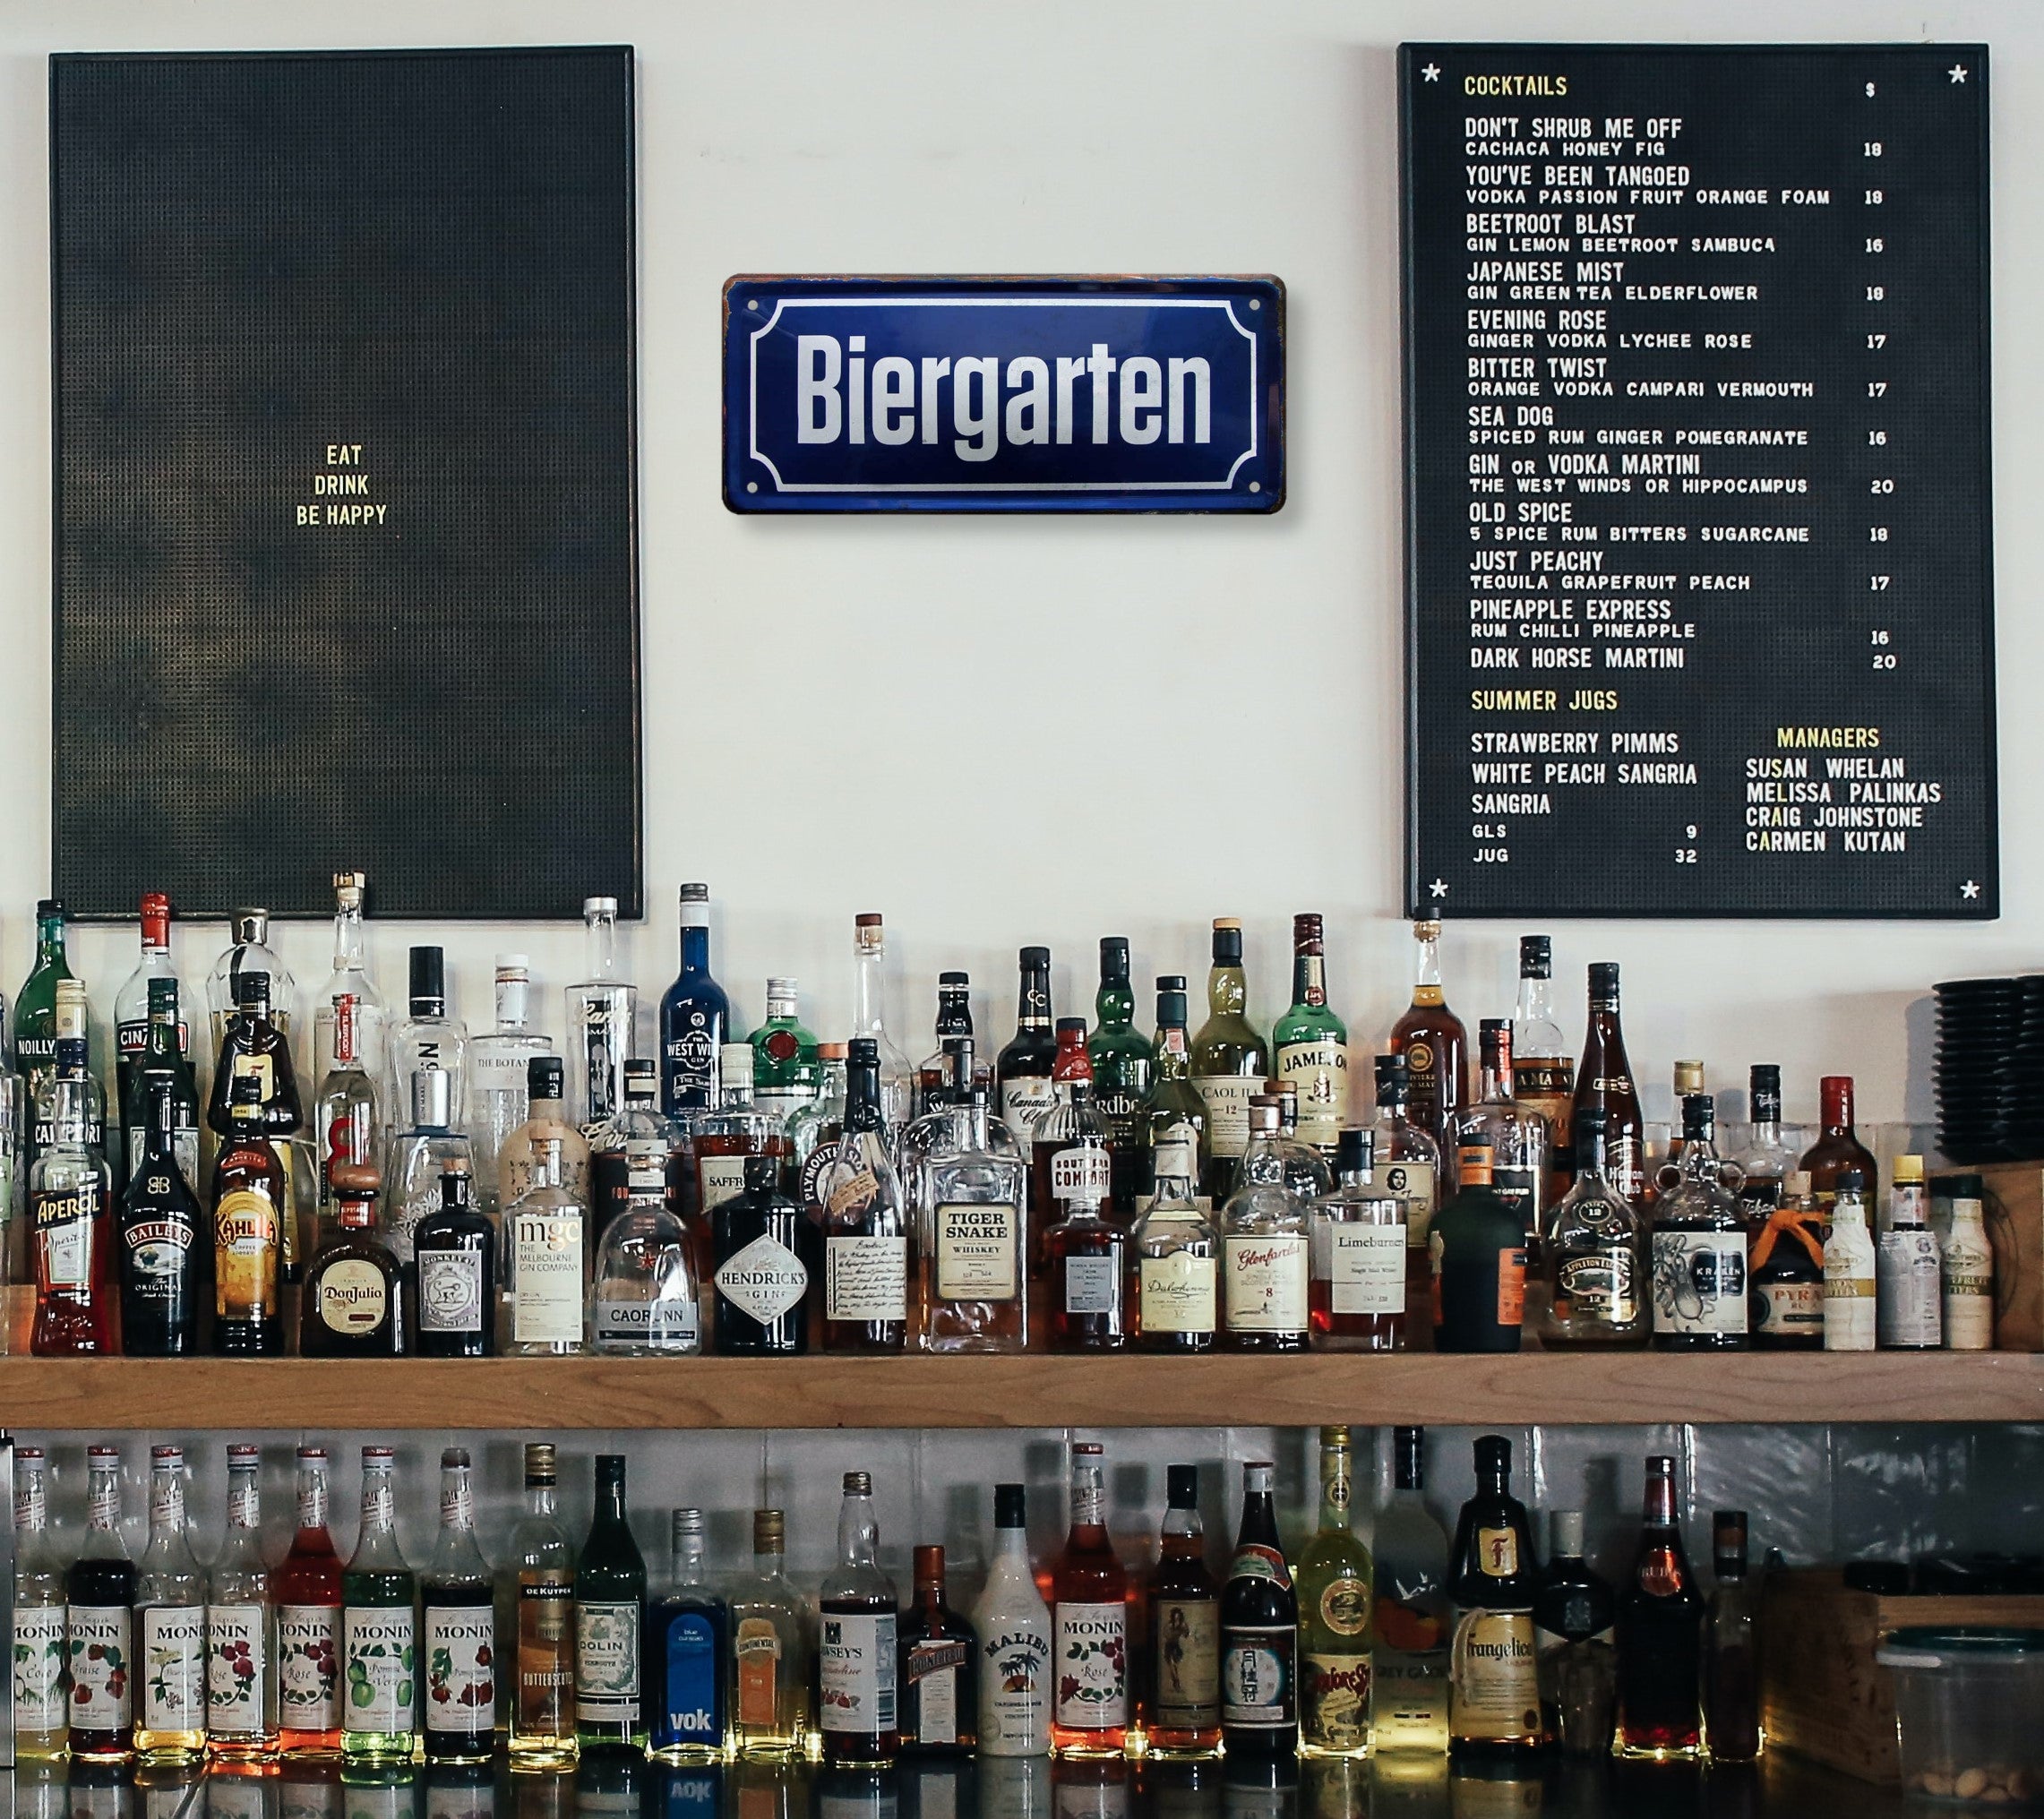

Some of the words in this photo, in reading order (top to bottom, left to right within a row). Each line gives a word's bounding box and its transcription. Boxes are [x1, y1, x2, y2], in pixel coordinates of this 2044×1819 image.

[1464, 75, 1567, 96] COCKTAILS
[1865, 82, 1876, 99] $
[1464, 116, 1519, 138] DON'T
[1532, 117, 1592, 139] SHRUB
[1604, 117, 1635, 139] ME
[1646, 117, 1682, 139] OFF
[1465, 141, 1550, 157] CACHACA
[1562, 142, 1623, 157] HONEY
[1636, 142, 1665, 157] FIG
[1864, 142, 1882, 158] 18
[1465, 164, 1532, 186] YOU'VE
[1544, 165, 1593, 186] BEEN
[1604, 165, 1690, 187] TANGOED
[1465, 189, 1526, 204] VODKA
[1539, 189, 1618, 205] PASSION
[1630, 189, 1684, 205] FRUIT
[1696, 189, 1768, 205] ORANGE
[1781, 189, 1830, 205] FOAM
[1865, 190, 1883, 205] 18
[1466, 213, 1563, 235] BEETROOT
[1576, 213, 1636, 235] BLAST
[1466, 236, 1497, 253] GIN
[1509, 237, 1570, 253] LEMON
[1582, 237, 1679, 253] BEETROOT
[1691, 237, 1775, 253] SAMBUCA
[1865, 237, 1884, 253] 16
[1466, 261, 1564, 282] JAPANESE
[1576, 262, 1625, 283] MIST
[1467, 285, 1498, 300] GIN
[1509, 285, 1571, 301] GREEN
[1576, 285, 1612, 301] TEA
[1625, 285, 1758, 301] ELDERFLOWER
[1866, 286, 1884, 301] 18
[1467, 309, 1546, 330] EVENING
[1559, 309, 1607, 331] ROSE
[1467, 333, 1534, 348] GINGER
[1546, 333, 1607, 348] VODKA
[1619, 333, 1692, 348] LYCHEE
[1705, 333, 1752, 349] ROSE
[1867, 334, 1886, 349] 17
[1468, 357, 1535, 379] BITTER
[1546, 357, 1608, 379] TWIST
[797, 334, 1212, 462] Biergarten
[1467, 381, 1541, 397] ORANGE
[1553, 381, 1614, 397] VODKA
[1626, 382, 1705, 397] CAMPARI
[1716, 382, 1814, 398] VERMOUTH
[1868, 382, 1887, 398] 17
[1468, 405, 1505, 427] SEA
[1516, 406, 1554, 426] DOG
[1469, 429, 1536, 445] SPICED
[1548, 429, 1585, 445] RUM
[1596, 429, 1663, 445] GINGER
[1675, 430, 1808, 446] POMEGRANATE
[1868, 430, 1886, 446] 16
[327, 444, 362, 465] EAT
[1469, 453, 1499, 475] GIN
[1511, 459, 1536, 476] OR
[1547, 453, 1610, 475] VODKA
[1621, 453, 1700, 476] MARTINI
[314, 474, 369, 495] DRINK
[1469, 477, 1505, 493] THE
[1516, 477, 1567, 493] WEST
[1576, 477, 1631, 493] WINDS
[1645, 478, 1670, 493] OR
[1682, 478, 1808, 494] HIPPOCAMPUS
[1870, 479, 1894, 494] 20
[296, 505, 321, 526] BE
[327, 504, 387, 526] HAPPY
[1469, 502, 1506, 523] OLD
[1517, 502, 1573, 523] SPICE
[1469, 526, 1481, 541] 5
[1494, 526, 1548, 542] SPICE
[1561, 526, 1598, 542] RUM
[1610, 526, 1688, 542] BITTERS
[1701, 527, 1809, 543] SUGARCANE
[1870, 527, 1888, 543] 18
[1469, 550, 1518, 571] JUST
[1530, 550, 1603, 572] PEACHY
[1470, 574, 1549, 590] TEQUILA
[1561, 574, 1677, 590] GRAPEFRUIT
[1689, 575, 1750, 590] PEACH
[1870, 575, 1890, 591] 17
[1470, 598, 1574, 621] PINEAPPLE
[1586, 599, 1671, 621] EXPRESS
[1471, 622, 1507, 638] RUM
[1519, 622, 1580, 639] CHILLI
[1593, 622, 1696, 639] PINEAPPLE
[1870, 630, 1889, 646] 16
[1471, 647, 1520, 669] DARK
[1532, 647, 1593, 669] HORSE
[1605, 647, 1684, 669] MARTINI
[1872, 654, 1897, 670] 20
[1471, 690, 1557, 711] SUMMER
[1568, 690, 1618, 710] JUGS
[1471, 732, 1599, 754] STRAWBERRY
[1611, 732, 1679, 754] PIMMS
[1777, 727, 1880, 749] MANAGERS
[1472, 762, 1533, 785] WHITE
[1544, 762, 1606, 785] PEACH
[1617, 763, 1697, 785] SANGRIA
[1746, 757, 1808, 779] SUSAN
[1825, 757, 1904, 779] WHELAN
[1747, 781, 1832, 803] MELISSA
[1850, 782, 1942, 804] PALINKAS
[1472, 793, 1551, 815] SANGRIA
[1746, 806, 1801, 828] CRAIG
[1813, 806, 1923, 828] JOHNSTONE
[1472, 824, 1507, 838] GLS
[1686, 824, 1697, 839] 9
[1746, 830, 1826, 852] CARMEN
[1843, 830, 1906, 853] KUTAN
[1473, 847, 1508, 863] JUG
[1675, 848, 1697, 863] 32
[18, 1039, 56, 1055] NOILLY
[666, 1042, 694, 1056] WEST
[478, 1059, 494, 1068] THE
[1202, 1086, 1238, 1099] CAOL
[1225, 1104, 1237, 1115] 12
[37, 1193, 100, 1224] APEROL
[948, 1213, 1005, 1225] TIGER
[129, 1224, 192, 1246] BAILEYS
[520, 1220, 580, 1251] mgc
[945, 1226, 1009, 1239] SNAKE
[520, 1244, 536, 1253] THE
[952, 1246, 1001, 1254] WHISKEY
[721, 1272, 805, 1285] HENDRICK'S
[1265, 1287, 1274, 1297] 8
[1064, 1621, 1123, 1635] MONIN
[579, 1641, 623, 1651] DOLIN
[670, 1709, 712, 1731] vok
